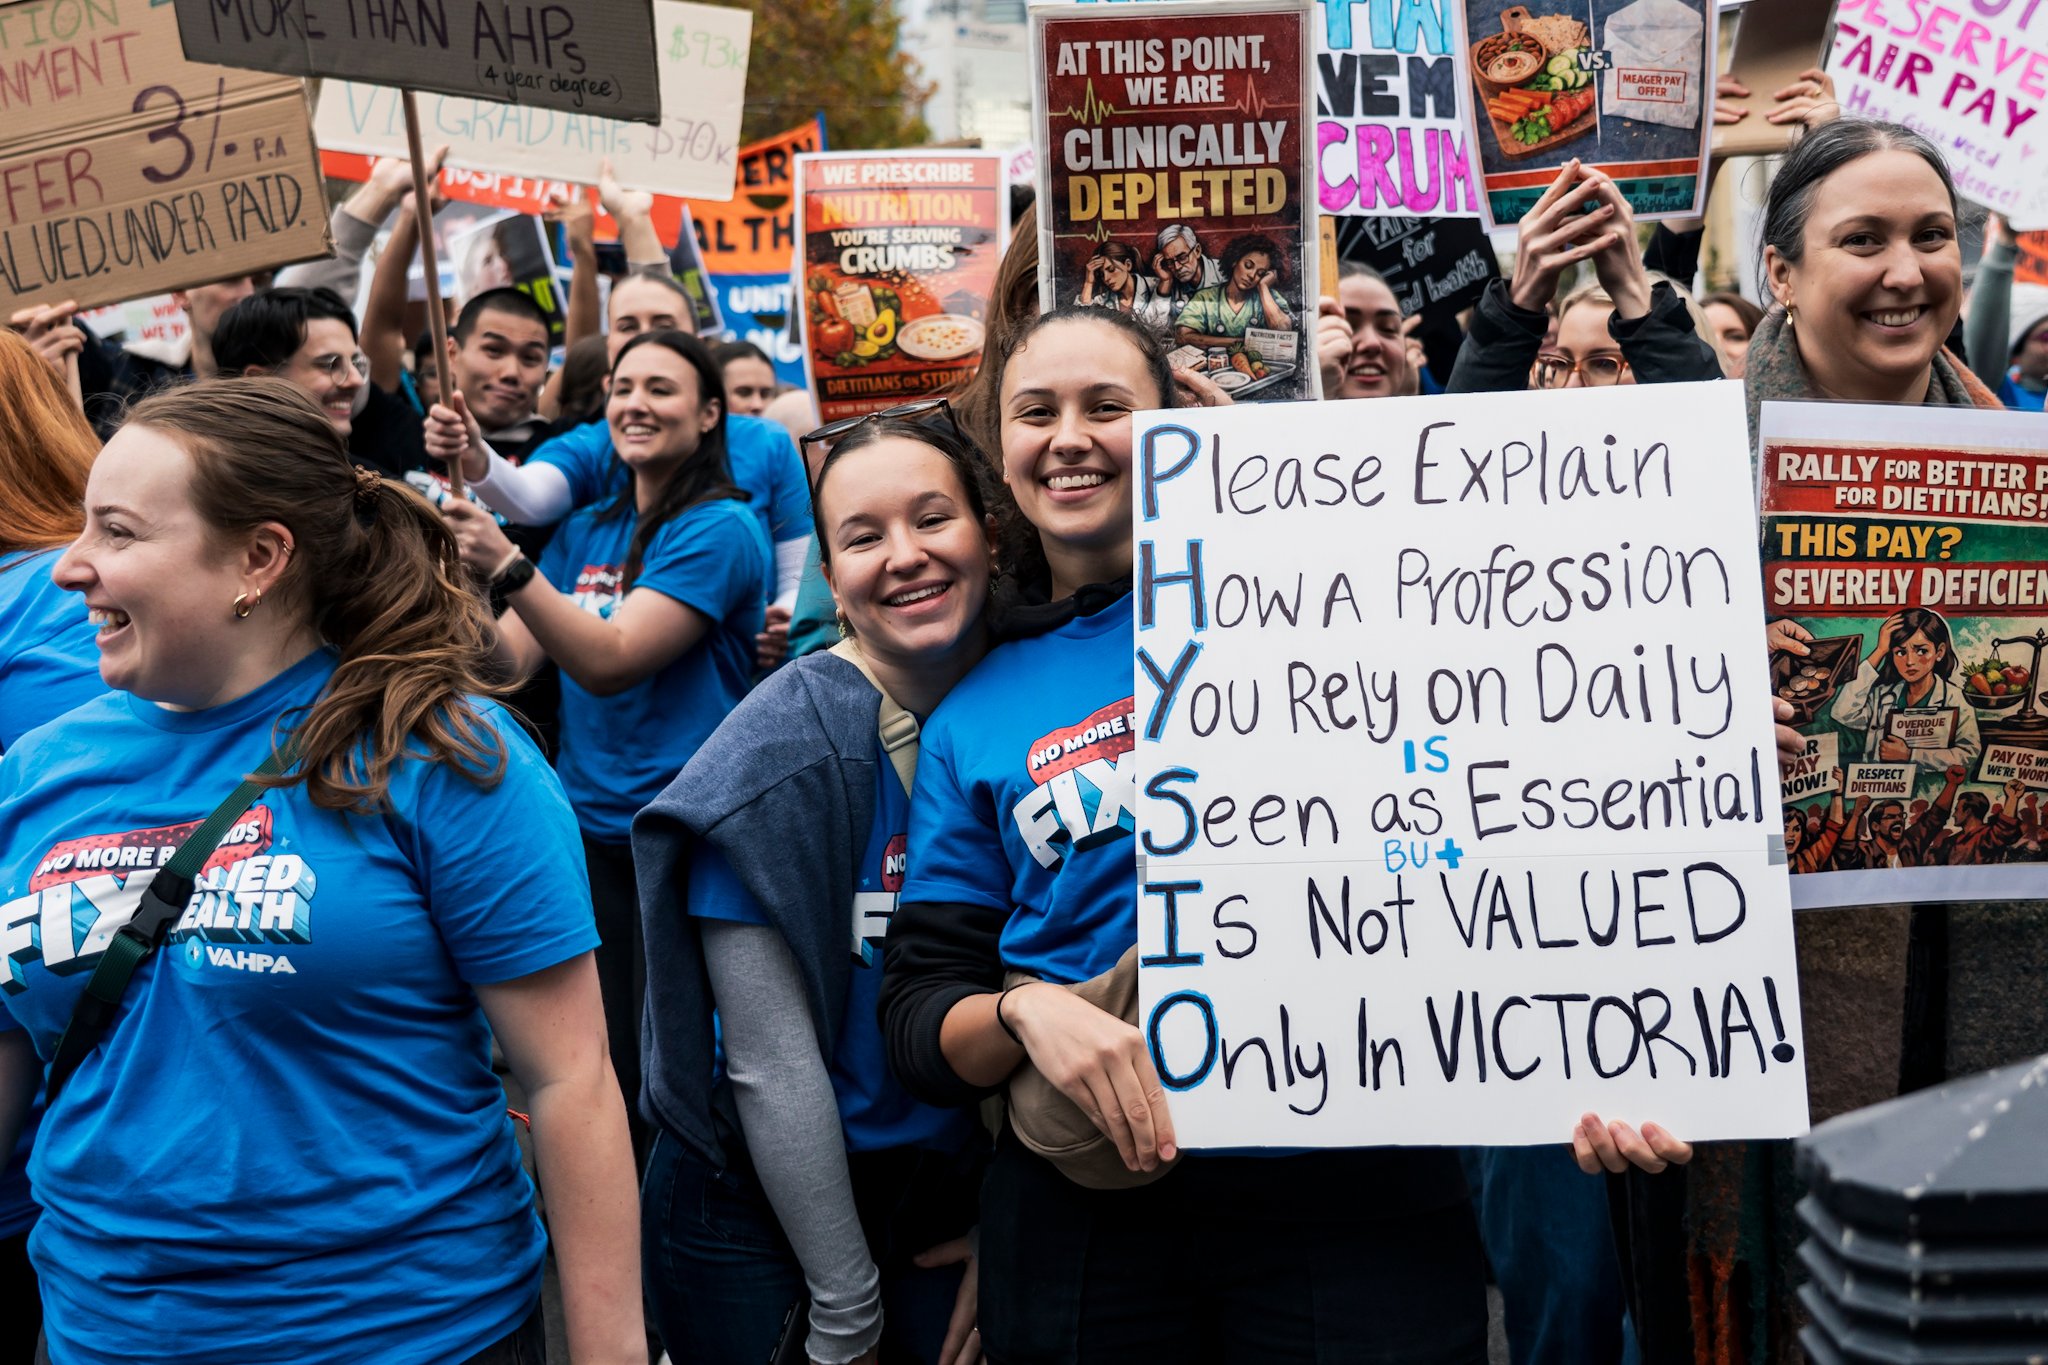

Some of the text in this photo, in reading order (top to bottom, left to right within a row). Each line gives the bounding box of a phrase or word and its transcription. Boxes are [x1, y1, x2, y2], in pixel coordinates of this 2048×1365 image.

[1056, 35, 1272, 77] AT THIS POINT,
[1578, 51, 1611, 70] VS.
[503, 71, 544, 102] year
[1125, 74, 1226, 106] WE ARE
[1622, 73, 1682, 87] MEAGER PAY
[1637, 86, 1667, 97] OFFER
[1940, 72, 2038, 139] PAY
[1062, 121, 1289, 173] CLINICALLY
[822, 162, 975, 185] WE PRESCRIBE
[221, 173, 307, 243] PAID.
[822, 193, 982, 225] NUTRITION,
[1068, 168, 1289, 222] DEPLETED
[830, 227, 962, 248] YOU'RE SERVING
[1401, 230, 1437, 268] for
[839, 246, 956, 275] CRUMBS
[1141, 420, 1673, 522] Please Explain
[1777, 452, 1880, 483] RALLY
[1884, 459, 1921, 480] FOR
[1926, 459, 2028, 491] BETTER
[1834, 485, 2048, 520] FOR DIETITIANS!
[1775, 523, 1963, 560] THIS PAY?
[1397, 541, 1732, 630] Profession
[1773, 567, 1914, 606] SEVERELY
[1288, 660, 1398, 744] Rely
[1427, 667, 1508, 727] on
[1535, 642, 1734, 741] Daily
[1896, 717, 1946, 730] OVERDUE
[1904, 727, 1935, 739] BILLS
[1031, 743, 1062, 771] NO
[1064, 715, 1126, 754] MORE
[1990, 749, 2016, 764] PAY
[2016, 752, 2034, 767] US
[1781, 771, 1828, 799] NOW!
[1857, 768, 1905, 780] RESPECT
[1986, 764, 2016, 778] WE'RE
[1141, 747, 1766, 858] Seen as Essential
[36, 846, 156, 878] NO MORE
[1307, 873, 1416, 959] Not
[1439, 861, 1747, 951] VALUED
[205, 945, 298, 975] VAHPA
[1147, 975, 1796, 1117] Only In VICTORIA!
